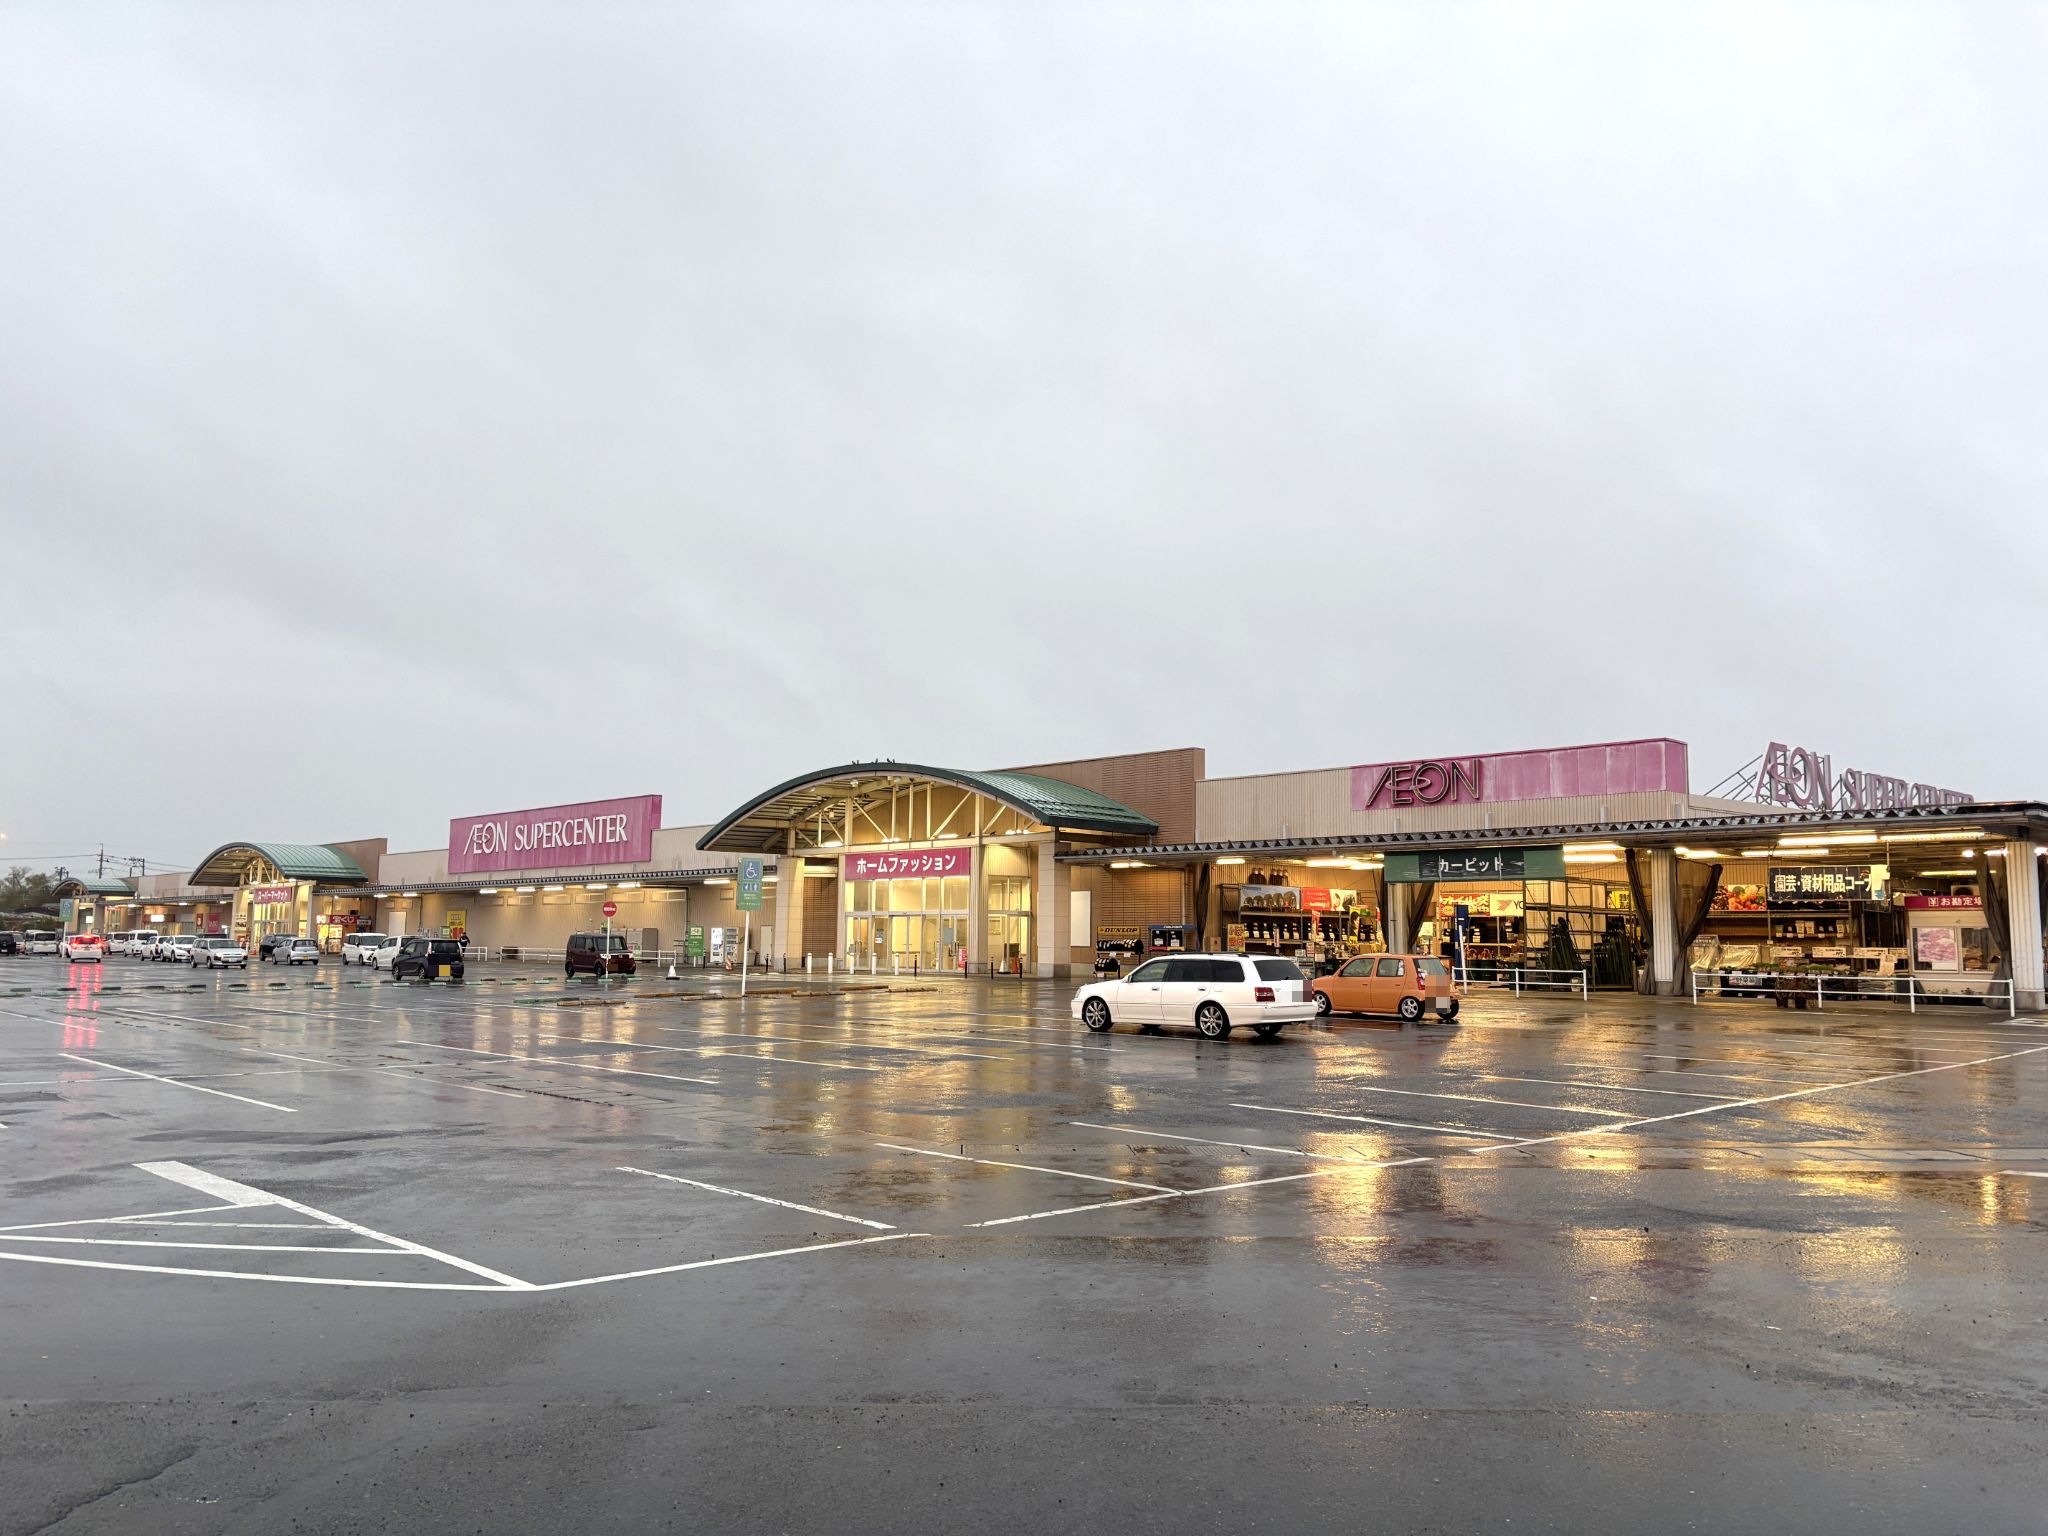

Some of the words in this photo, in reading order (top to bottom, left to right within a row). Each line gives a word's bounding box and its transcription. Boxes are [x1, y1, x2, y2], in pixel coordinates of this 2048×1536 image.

[514, 813, 629, 851] SUPERCENTER
[856, 854, 957, 875] ホームファッション
[1439, 857, 1504, 872] カーピット
